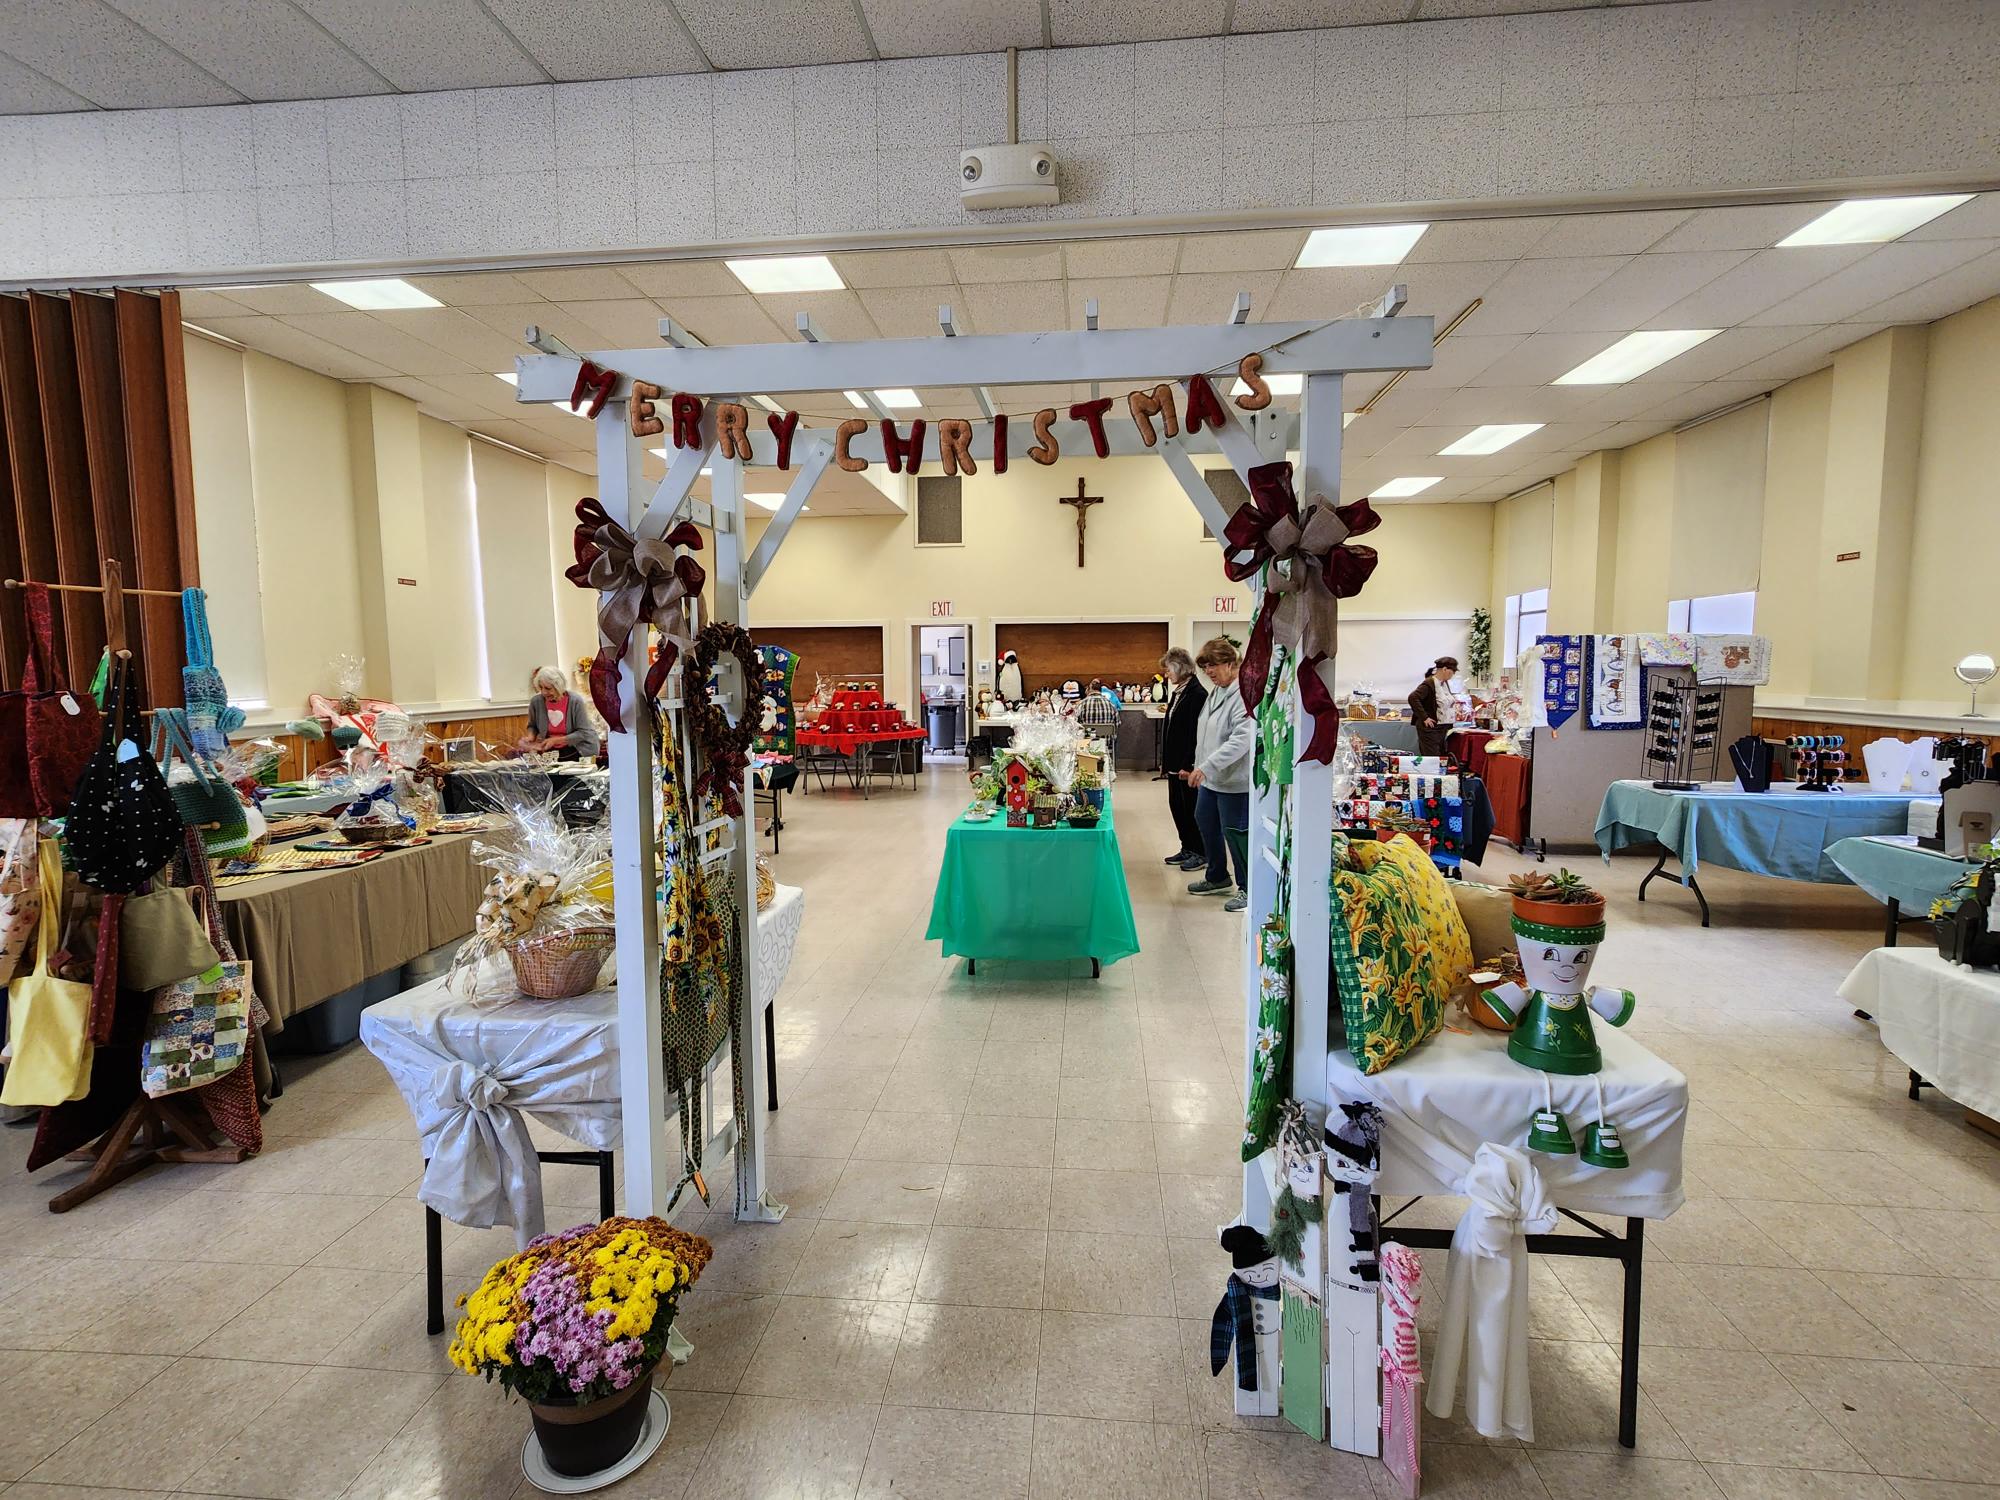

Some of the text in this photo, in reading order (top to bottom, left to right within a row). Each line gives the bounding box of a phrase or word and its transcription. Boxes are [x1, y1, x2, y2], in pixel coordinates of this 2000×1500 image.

[570, 352, 1272, 476] MERRY CHRISTMAS
[932, 601, 951, 616] EXIT
[1215, 597, 1236, 612] EXIT
